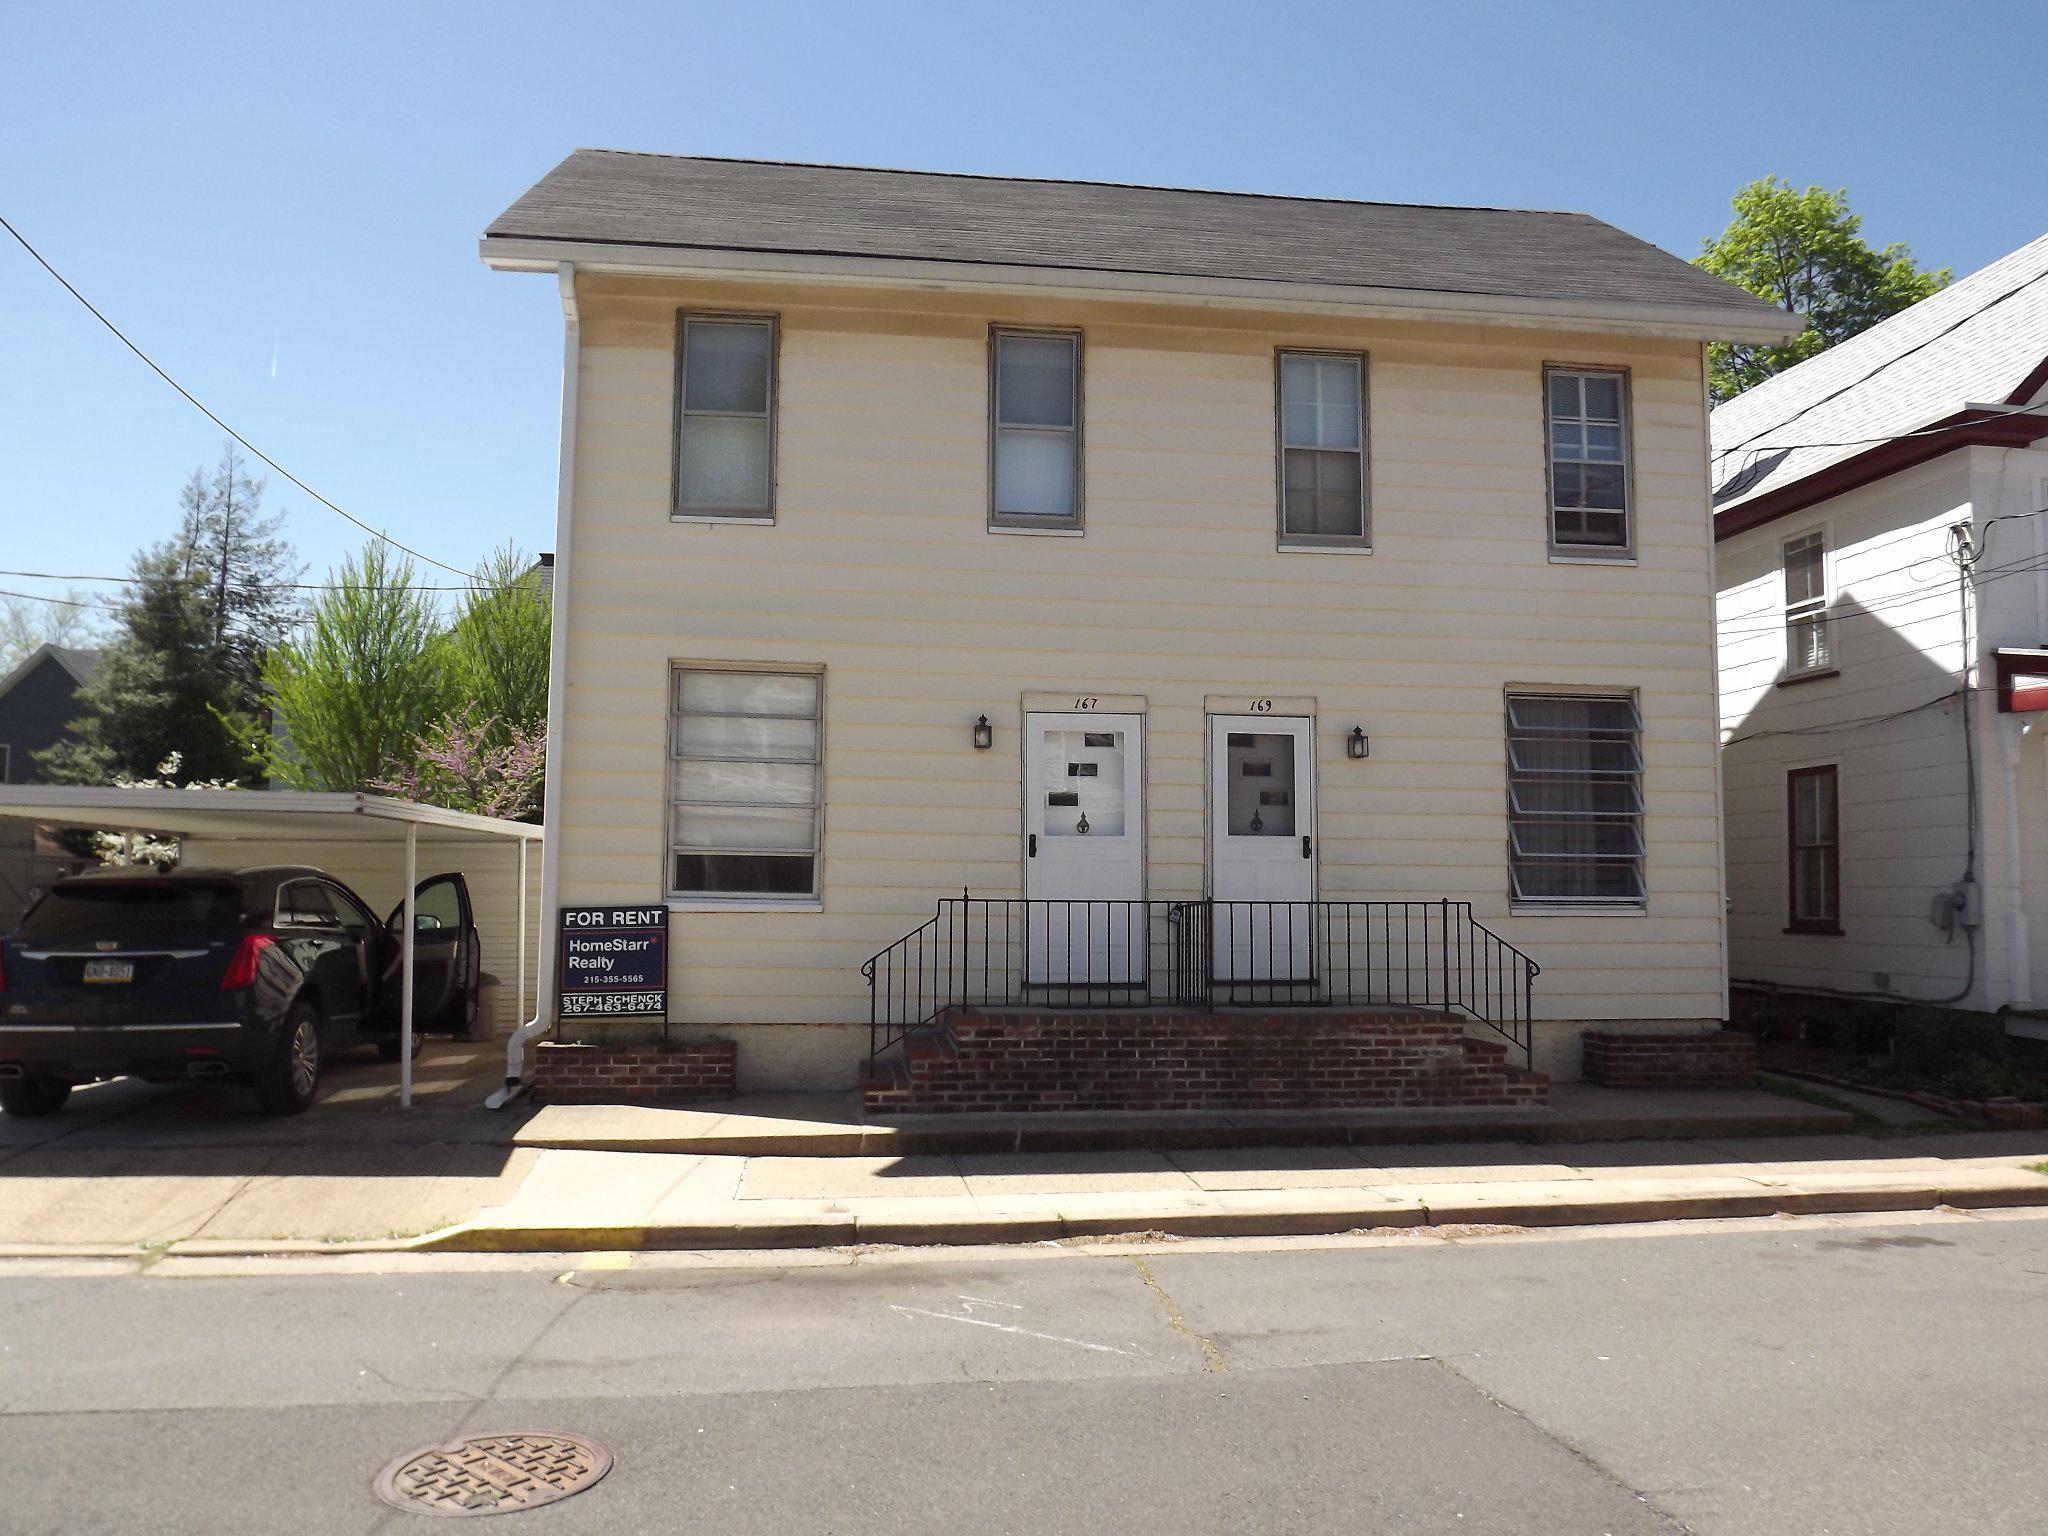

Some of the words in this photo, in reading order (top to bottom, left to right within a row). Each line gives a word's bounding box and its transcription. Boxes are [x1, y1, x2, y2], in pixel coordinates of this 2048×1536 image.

[1074, 698, 1097, 709] 167
[1250, 700, 1271, 711] 169
[565, 912, 604, 926] FOR
[612, 911, 662, 925] RENT
[569, 938, 649, 952] HomeStarr
[568, 956, 615, 971] Realty
[583, 974, 644, 984] 215-355-5565
[563, 996, 602, 1005] STEPH
[606, 994, 662, 1003] SCHENCK
[563, 1003, 661, 1012] 267-463-6474
